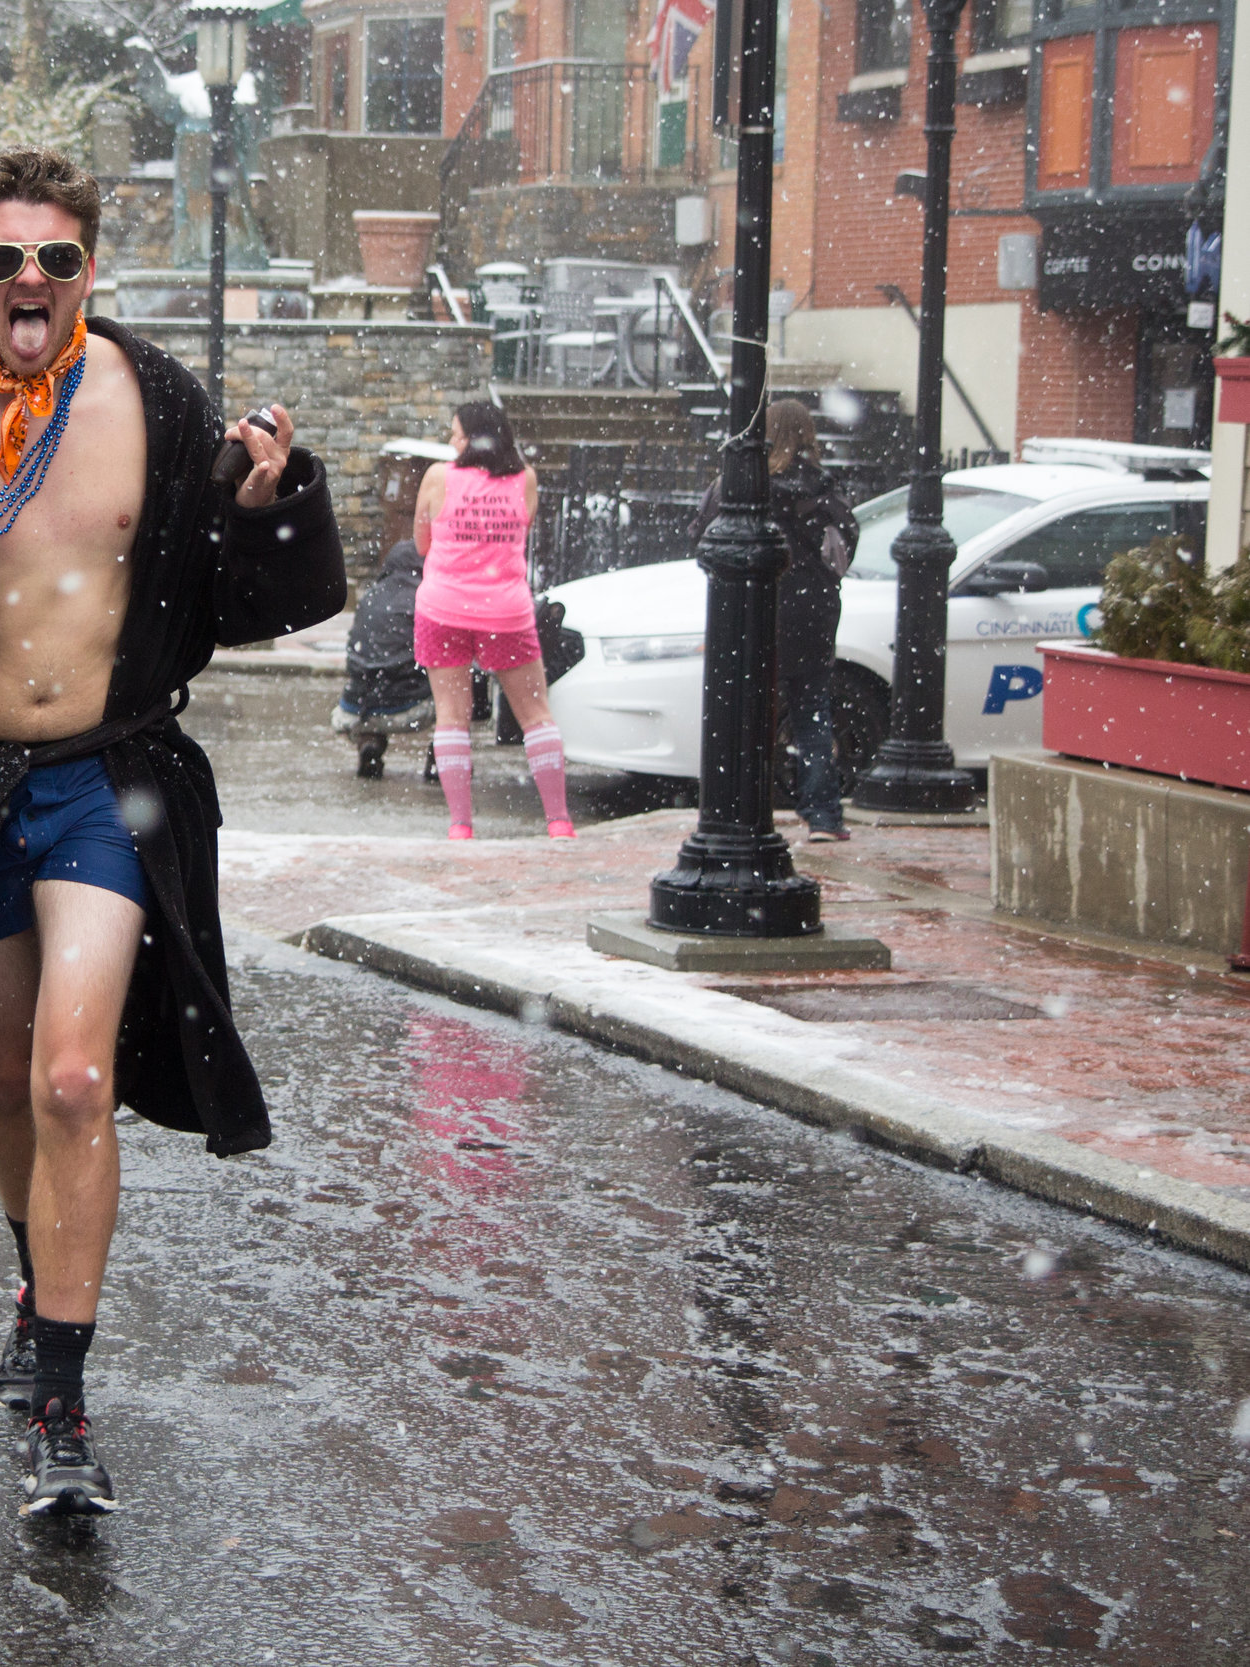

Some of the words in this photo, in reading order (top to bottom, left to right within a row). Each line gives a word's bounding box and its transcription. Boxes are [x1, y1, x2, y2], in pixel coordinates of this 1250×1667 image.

[462, 495, 478, 505] WE
[483, 495, 511, 505] LOVE
[455, 508, 466, 518] IT
[472, 508, 507, 518] WHEN
[449, 520, 480, 530] CURE
[484, 520, 521, 530] COMES
[455, 533, 516, 543] TOGETHER
[976, 620, 1074, 636] CINCINNATI
